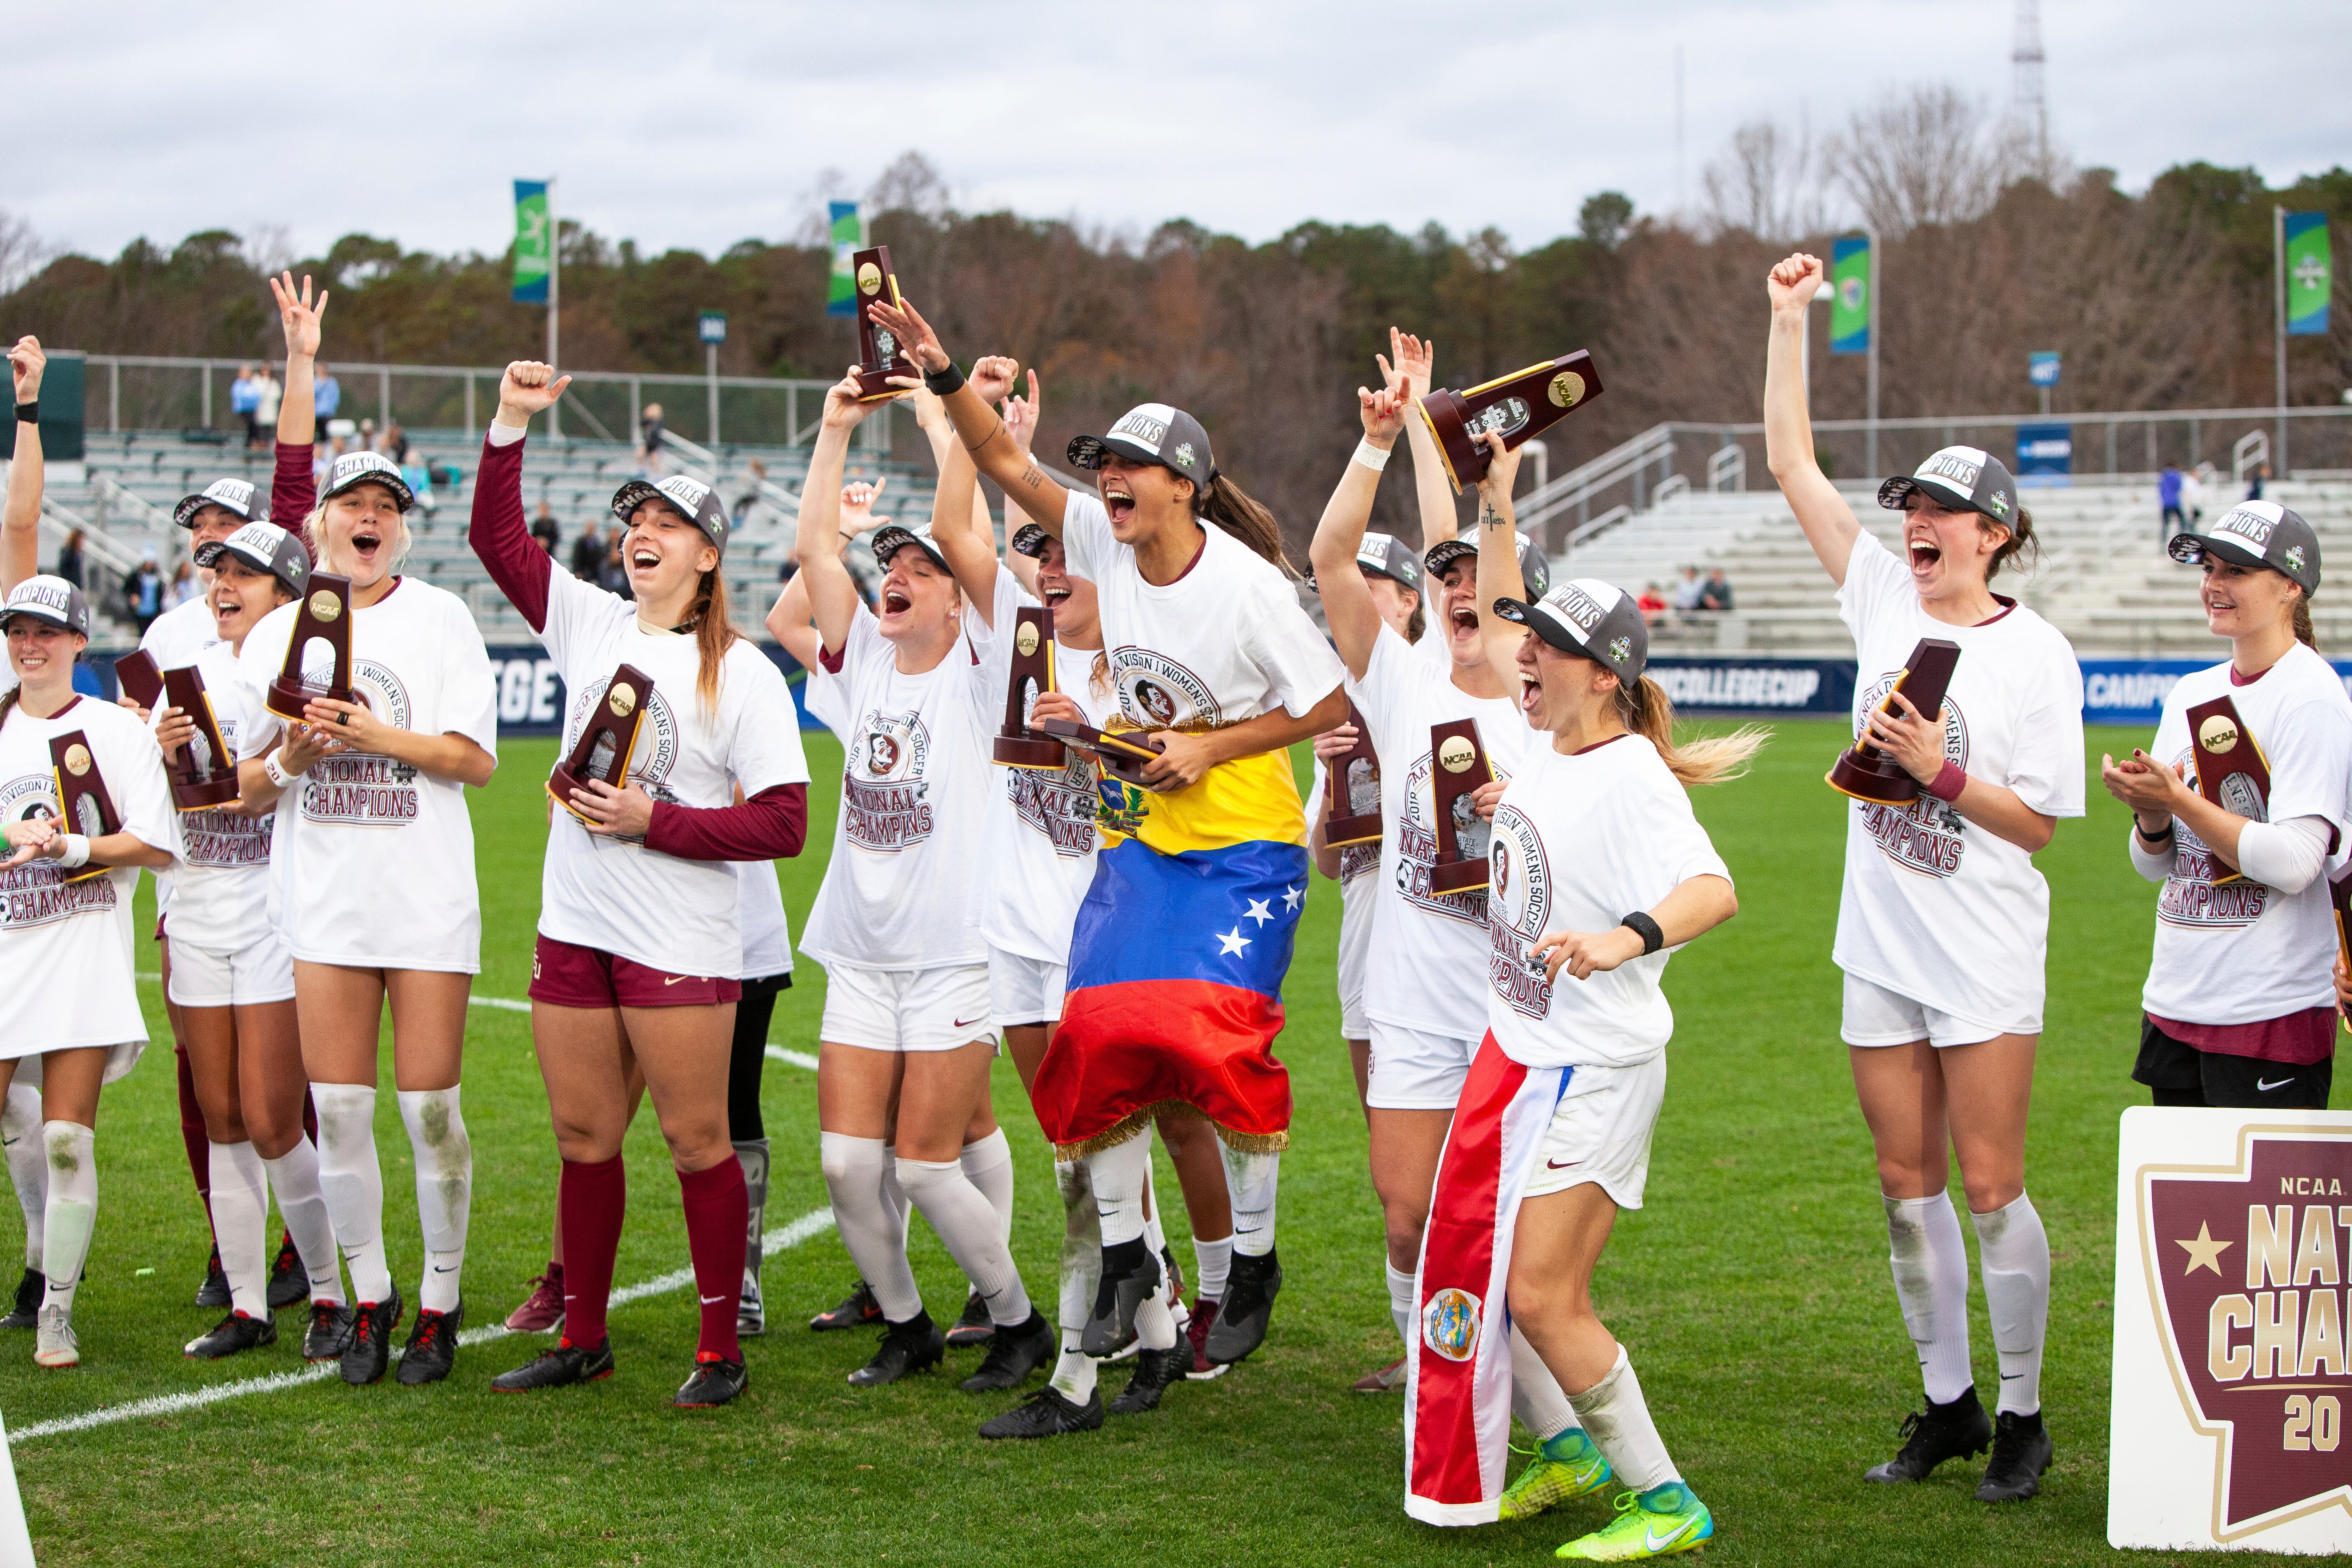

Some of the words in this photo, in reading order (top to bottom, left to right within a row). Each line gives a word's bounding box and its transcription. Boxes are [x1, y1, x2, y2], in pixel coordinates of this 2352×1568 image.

[1515, 401, 1524, 413] 2018
[1554, 377, 1573, 407] NCAA
[1508, 398, 1520, 418] DIVISION
[312, 602, 339, 616] NCAA
[1581, 593, 1604, 615] NATIONAL
[362, 665, 402, 706] WOMEN'S
[1162, 663, 1207, 707] WOMEN'S
[648, 696, 670, 736] OMEN'S
[911, 732, 925, 775] SOCCER
[2205, 729, 2238, 749] NCAA
[267, 763, 279, 782] 20
[306, 757, 393, 785] NATIONAL
[647, 739, 670, 781] SOCCER
[1443, 751, 1475, 766] NCAA
[3, 780, 41, 808] DIVISION
[308, 784, 419, 820] CHAMPIONS
[1410, 792, 1420, 822] 2018
[187, 831, 271, 863] CHAMPION
[1519, 827, 1542, 884] WOMEN'S
[8, 877, 118, 922] CHAMPIONS
[1524, 887, 1543, 936] SOCCER
[2281, 1177, 2342, 1196] NCAA
[2208, 1289, 2352, 1382] CHA
[2283, 1395, 2340, 1452] 20
